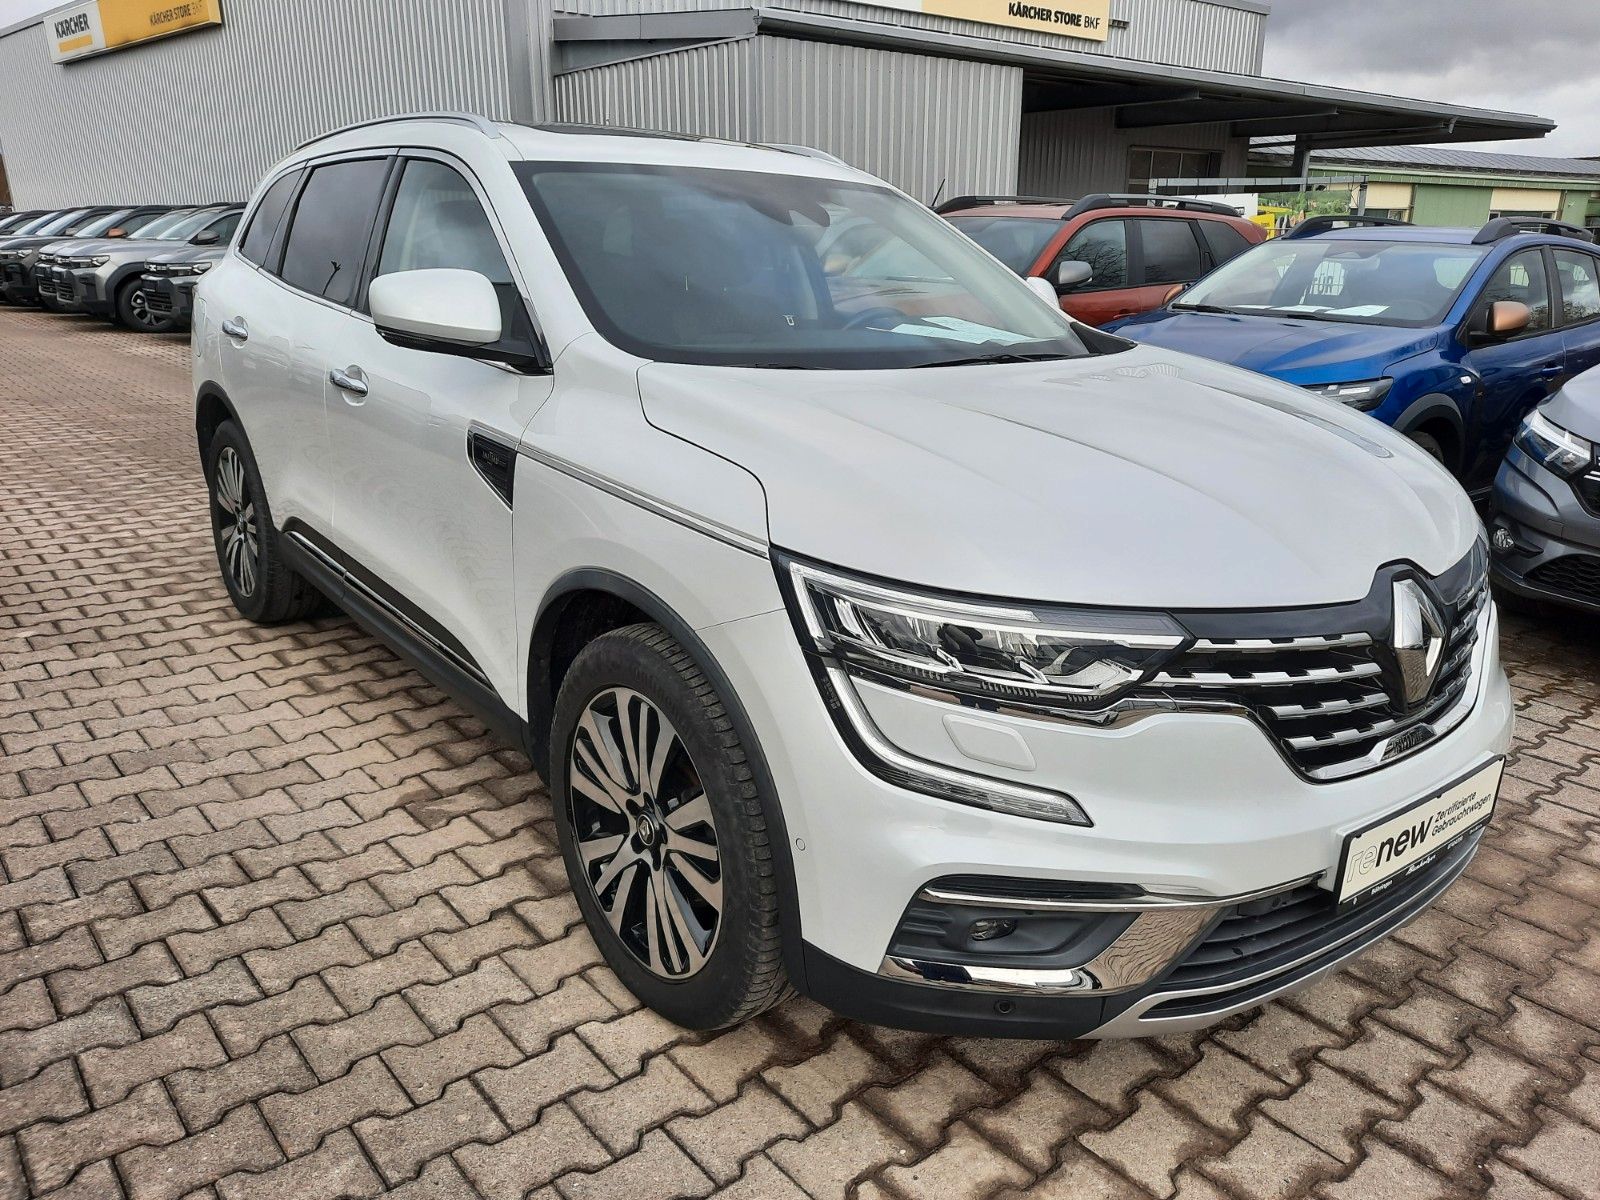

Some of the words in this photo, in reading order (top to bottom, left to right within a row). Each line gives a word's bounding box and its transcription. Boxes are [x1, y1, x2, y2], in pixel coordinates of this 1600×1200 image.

[54, 13, 90, 38] KÄRCHER
[150, 9, 173, 26] KÄRCHER
[174, 4, 192, 21] STORE
[1008, 2, 1052, 22] KÄRCHER
[1053, 10, 1082, 27] STORE
[1083, 15, 1101, 29] BKF
[1431, 793, 1492, 837] Gebrauchtwagen
[1435, 792, 1476, 822] Zertifizierte
[1347, 815, 1434, 883] renew
